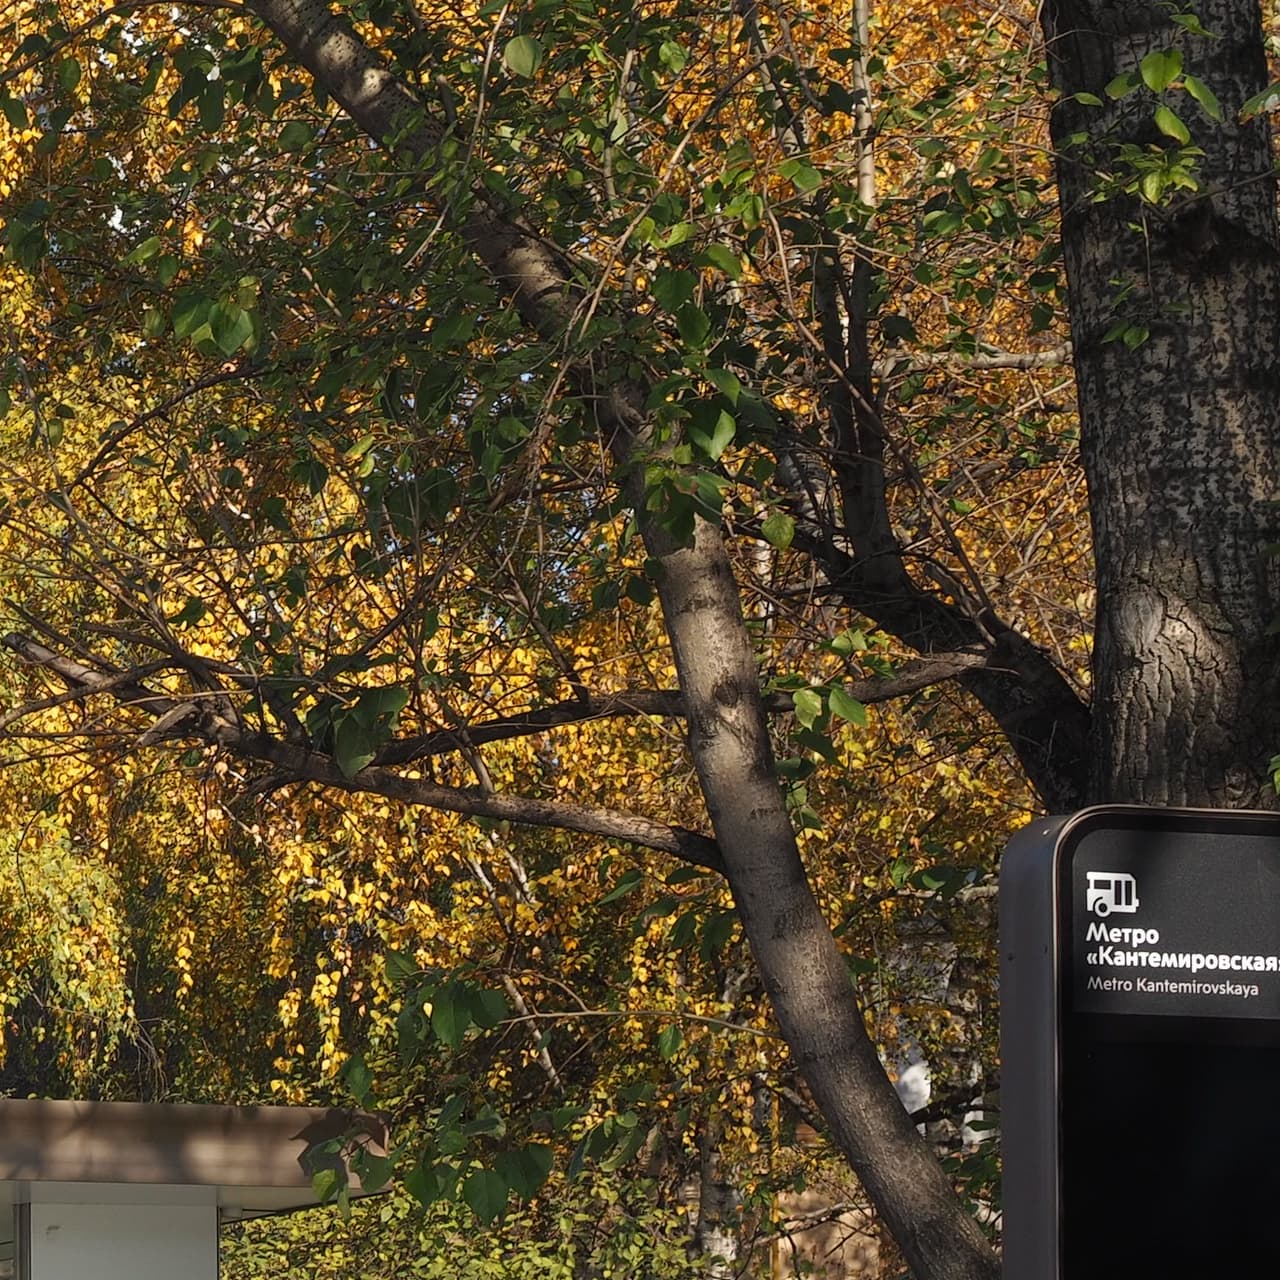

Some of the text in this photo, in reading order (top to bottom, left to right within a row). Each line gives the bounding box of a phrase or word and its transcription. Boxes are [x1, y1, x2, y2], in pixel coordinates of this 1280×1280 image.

[1085, 921, 1160, 948] Метро
[1087, 976, 1260, 998] Metro Kantemirovskaya
